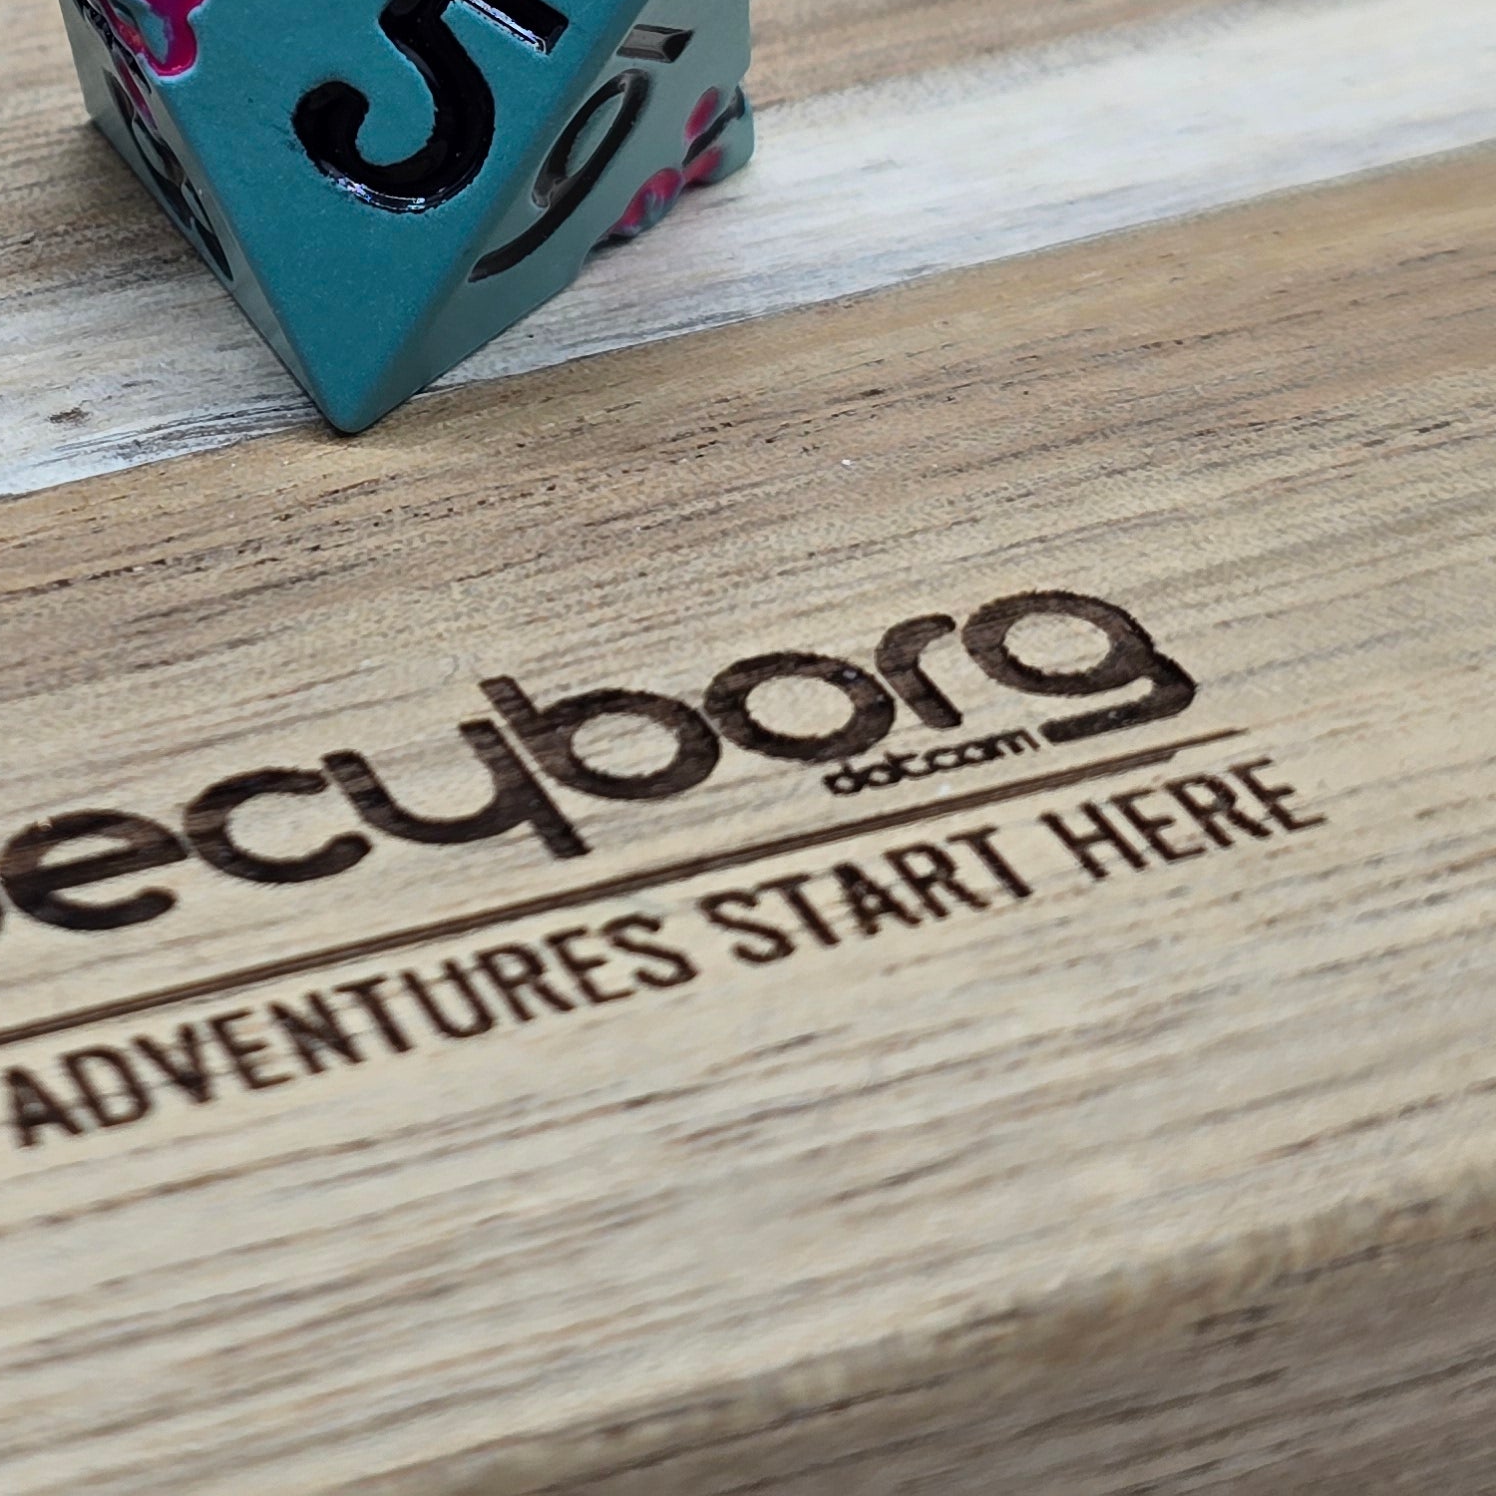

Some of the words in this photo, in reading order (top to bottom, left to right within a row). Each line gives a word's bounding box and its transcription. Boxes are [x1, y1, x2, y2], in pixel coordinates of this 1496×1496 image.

[822, 728, 1041, 795] dotcom
[1, 912, 701, 1149] ADVENTURES
[704, 826, 1036, 968] START
[1040, 757, 1327, 882] HERE
